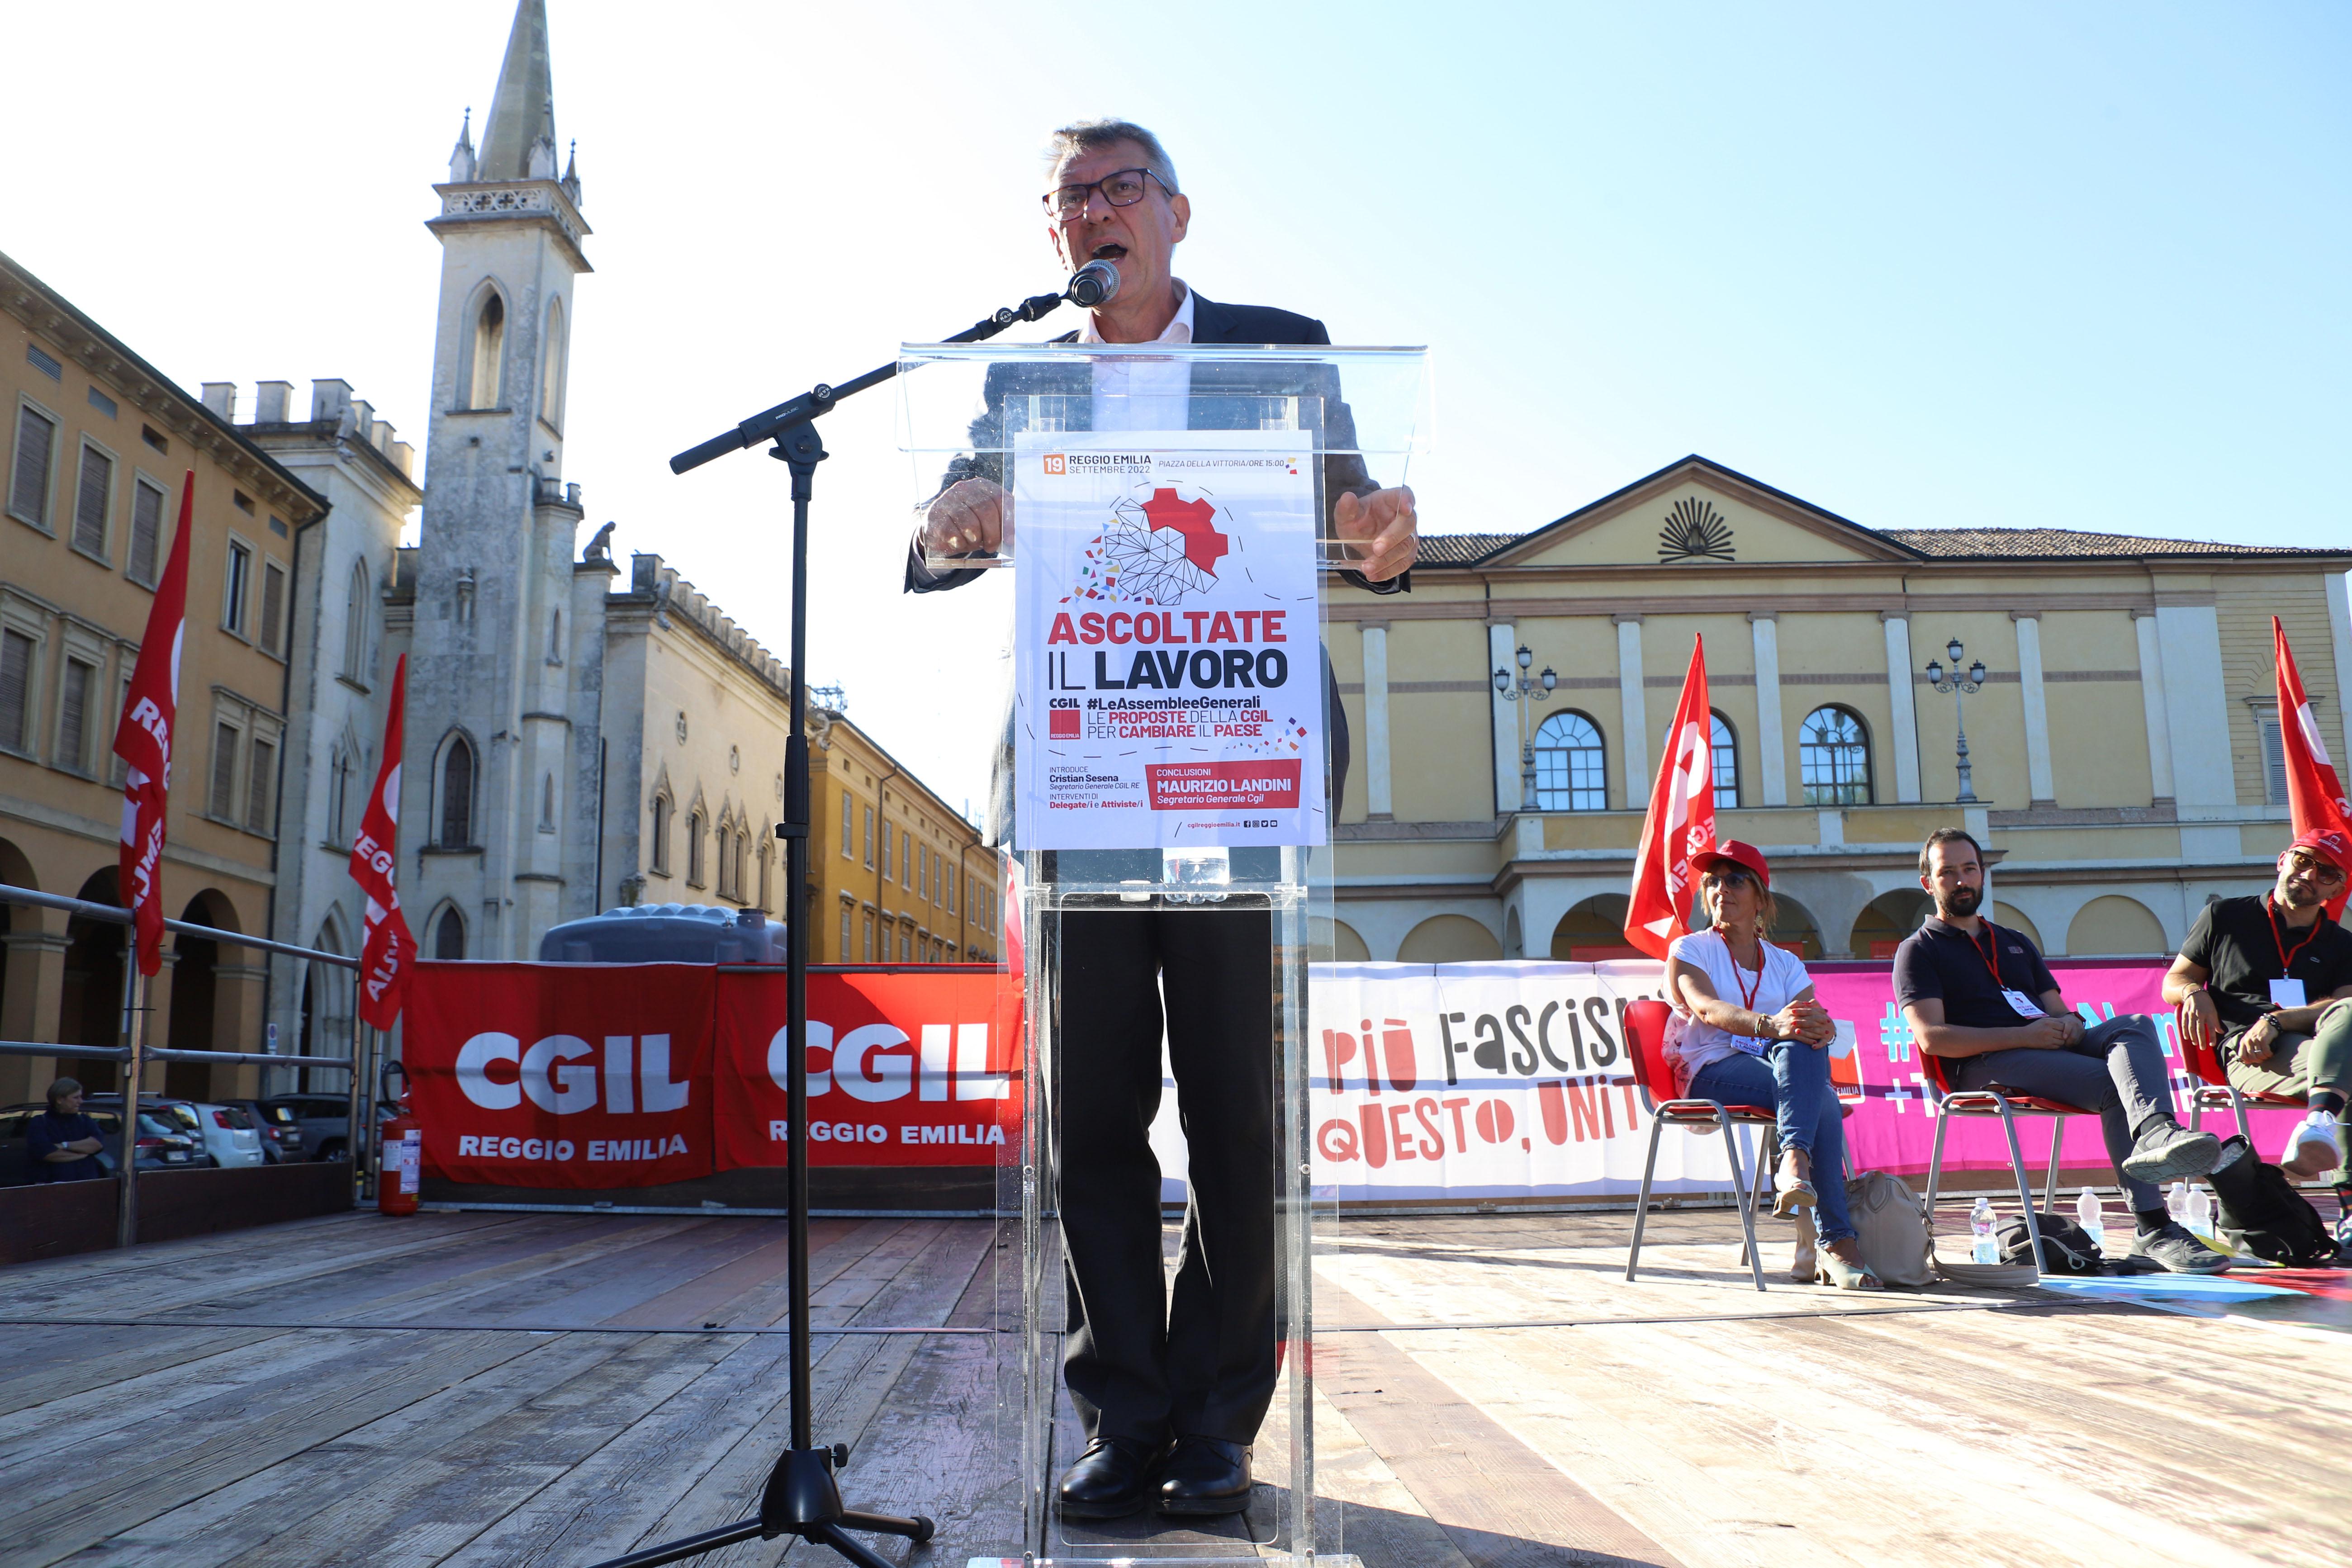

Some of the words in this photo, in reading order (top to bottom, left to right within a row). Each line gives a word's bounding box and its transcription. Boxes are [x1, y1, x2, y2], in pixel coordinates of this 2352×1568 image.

[1045, 457, 1063, 473] 19
[1069, 455, 1110, 464] REGGIO
[1113, 455, 1152, 464] EMILIA
[1048, 611, 1287, 644] ASCOLTATE
[1049, 651, 1086, 690] IL
[1095, 649, 1288, 689] LAVORO
[1049, 698, 1080, 708] CGIL
[1087, 696, 1260, 710] #LeAssembleeGenerali
[1088, 712, 1106, 725] LE
[1109, 710, 1187, 724] PROPOSTE
[1190, 710, 1238, 723] DELLA
[1240, 710, 1274, 722] CGIL
[1088, 726, 1116, 739] PER
[1119, 725, 1196, 739] CAMBIARE
[1200, 725, 1211, 737] IL
[1214, 724, 1262, 737] PAESE
[1049, 774, 1084, 782] Cristian
[1086, 774, 1119, 782] Sesena
[1157, 768, 1211, 777] CONCLUSIONI
[1157, 779, 1228, 793] MAURIZIO
[1231, 778, 1291, 791] LANDINI
[1050, 801, 1093, 810] Delegate/i
[1101, 800, 1143, 808] Attiviste/i
[1157, 795, 1204, 805] Segretario
[1206, 794, 1245, 803] Generale
[1247, 794, 1264, 804] Cgil
[768, 1020, 1010, 1103] CGIL
[455, 1032, 689, 1115] CGIL
[1836, 1086, 1859, 1096] EMILIA
[769, 1120, 887, 1144] RGGIO
[901, 1124, 1005, 1145] EMILIA
[459, 1135, 575, 1161] REGGIO
[587, 1133, 688, 1161] EMILIA
